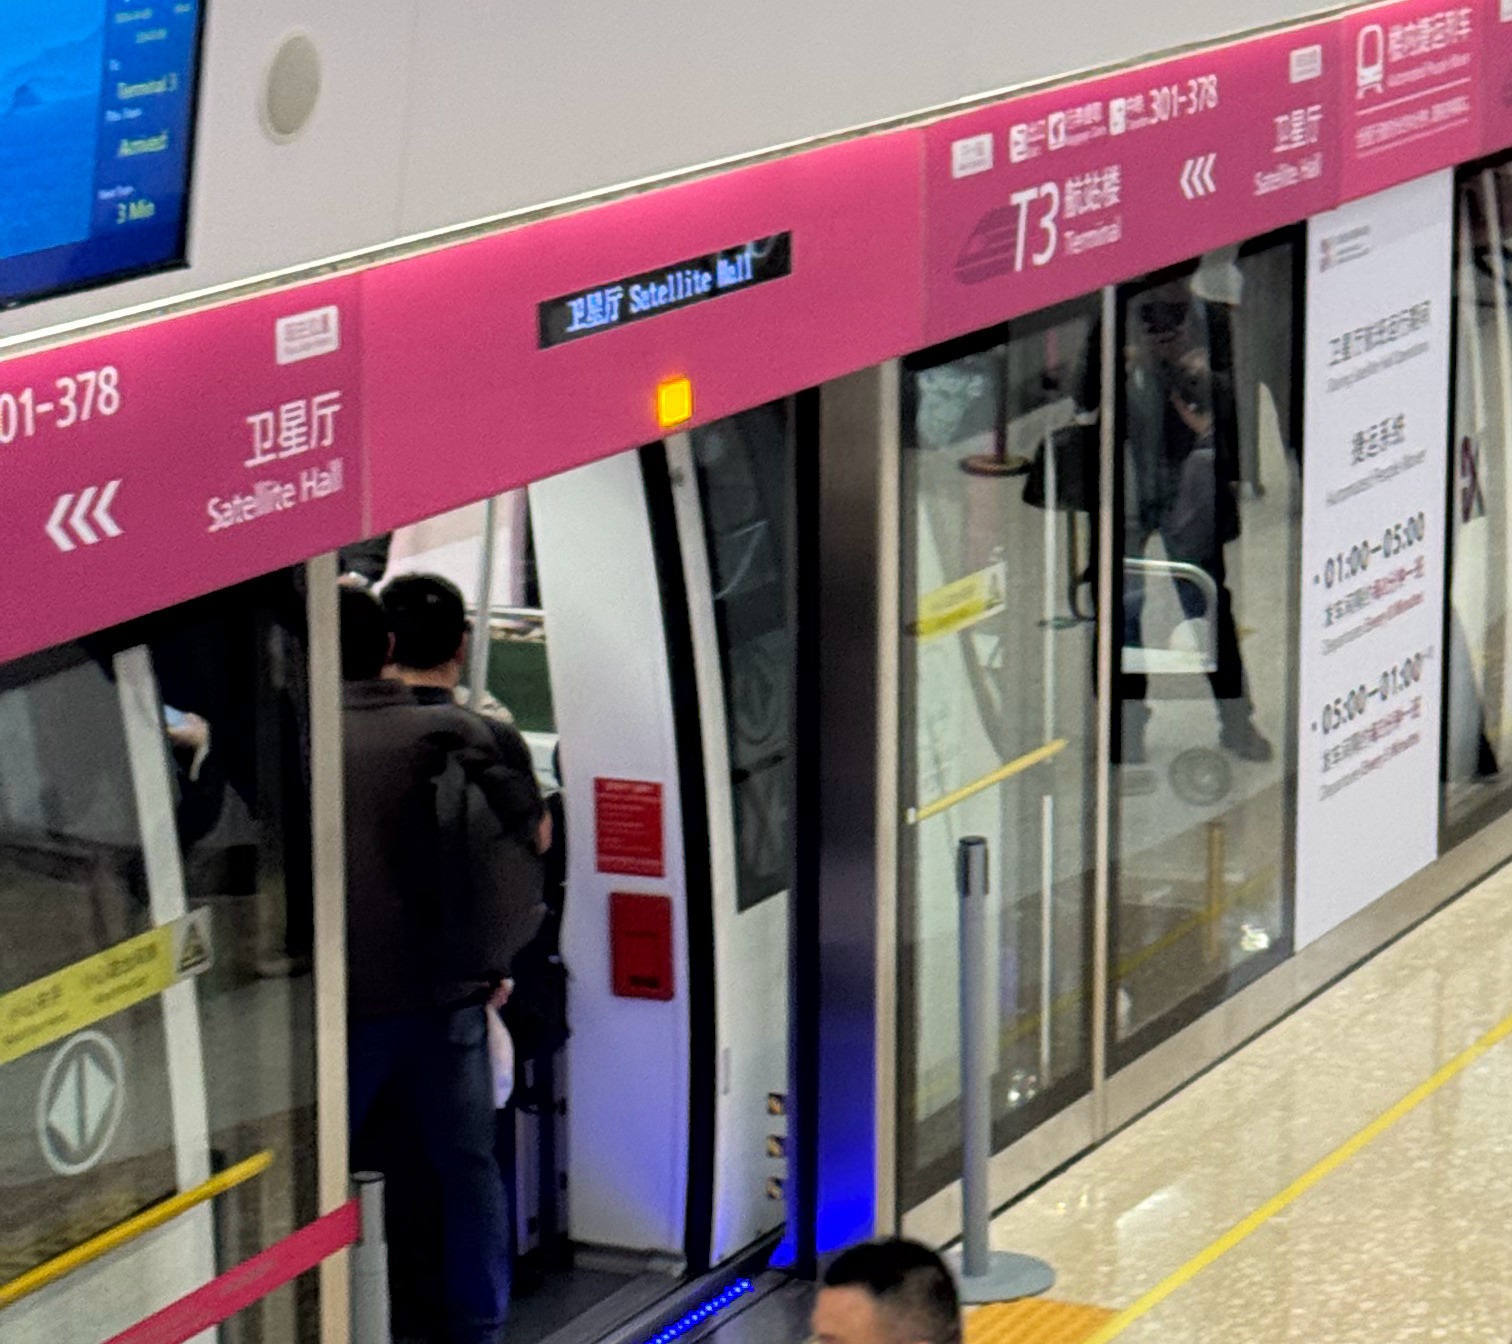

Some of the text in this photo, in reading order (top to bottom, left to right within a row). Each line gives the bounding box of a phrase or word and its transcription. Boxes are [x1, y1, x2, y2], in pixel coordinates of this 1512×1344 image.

[1148, 74, 1219, 125] 301-378
[1010, 181, 1061, 274] T3
[565, 285, 624, 334] 卫星厅
[628, 269, 713, 315] Satellite
[243, 389, 343, 468] 卫星厅
[206, 456, 345, 534] Satellite Hall
